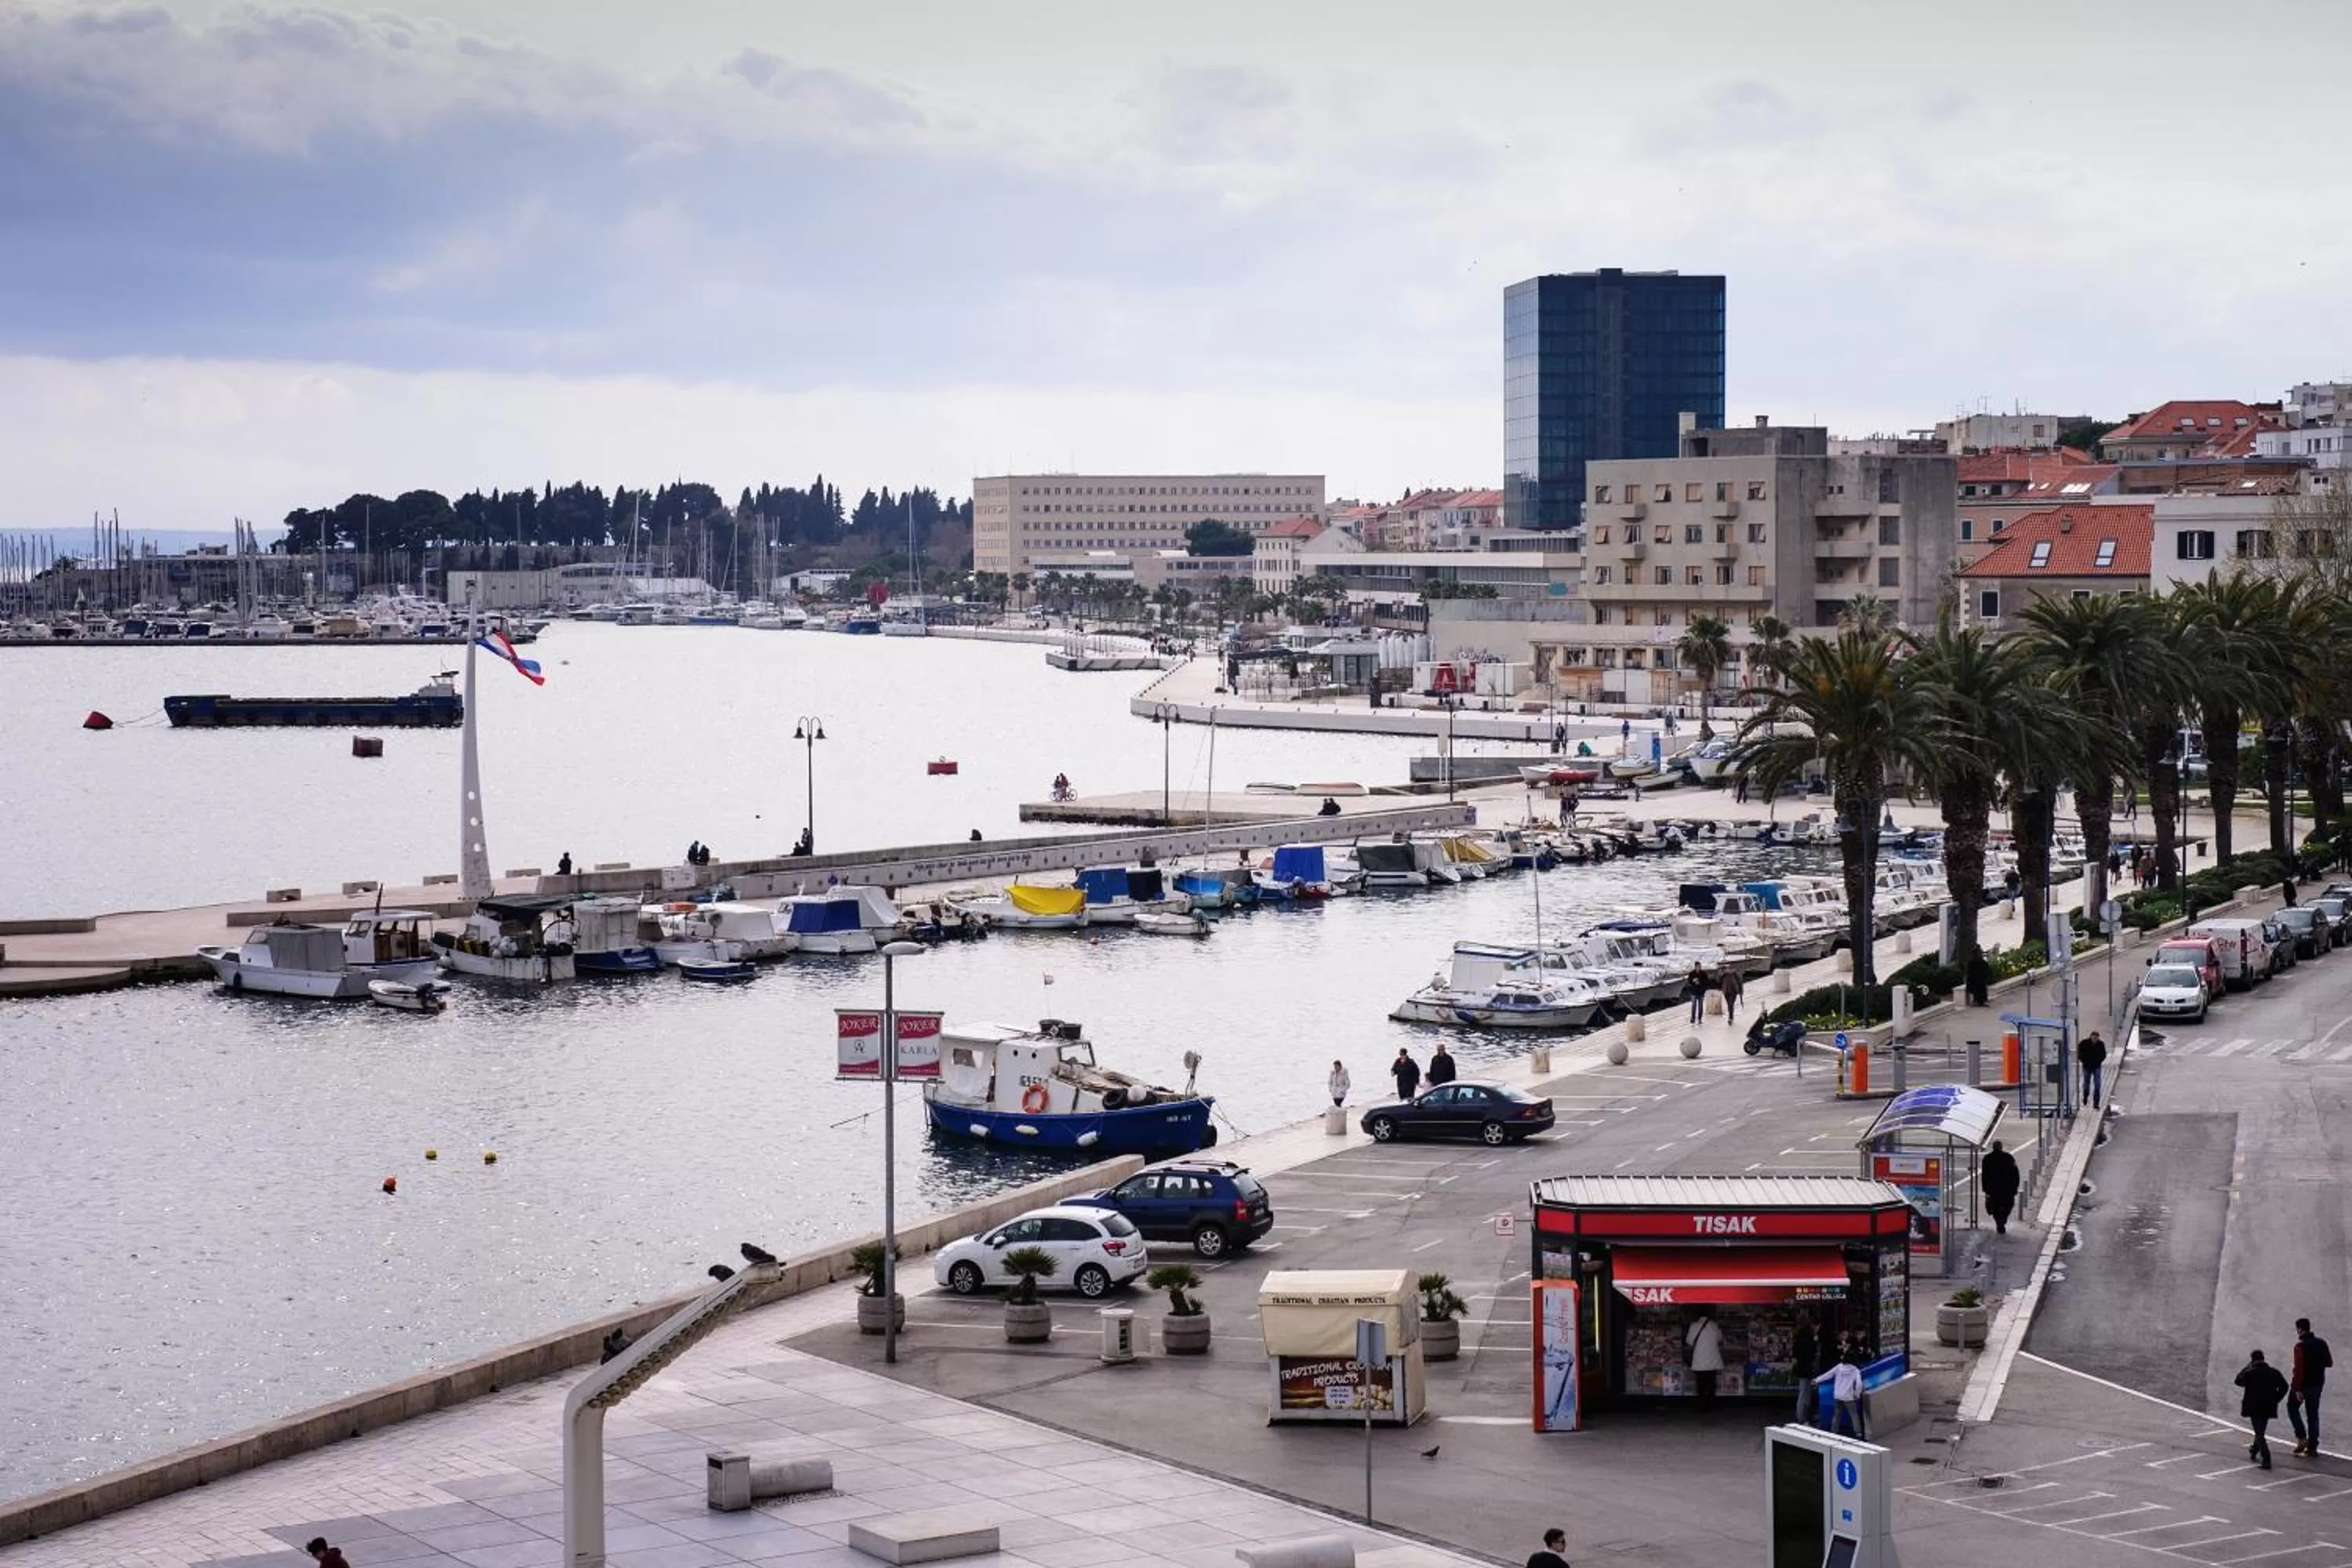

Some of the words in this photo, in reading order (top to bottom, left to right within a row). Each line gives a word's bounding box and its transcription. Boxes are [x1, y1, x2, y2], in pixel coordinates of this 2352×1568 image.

[840, 1018, 879, 1033] JOKER
[900, 1018, 938, 1033] JOKER
[1693, 1216, 1756, 1233] TISAK
[1280, 1362, 1342, 1380] TRADITIONAL
[1313, 1372, 1359, 1387] PRODUCTS
